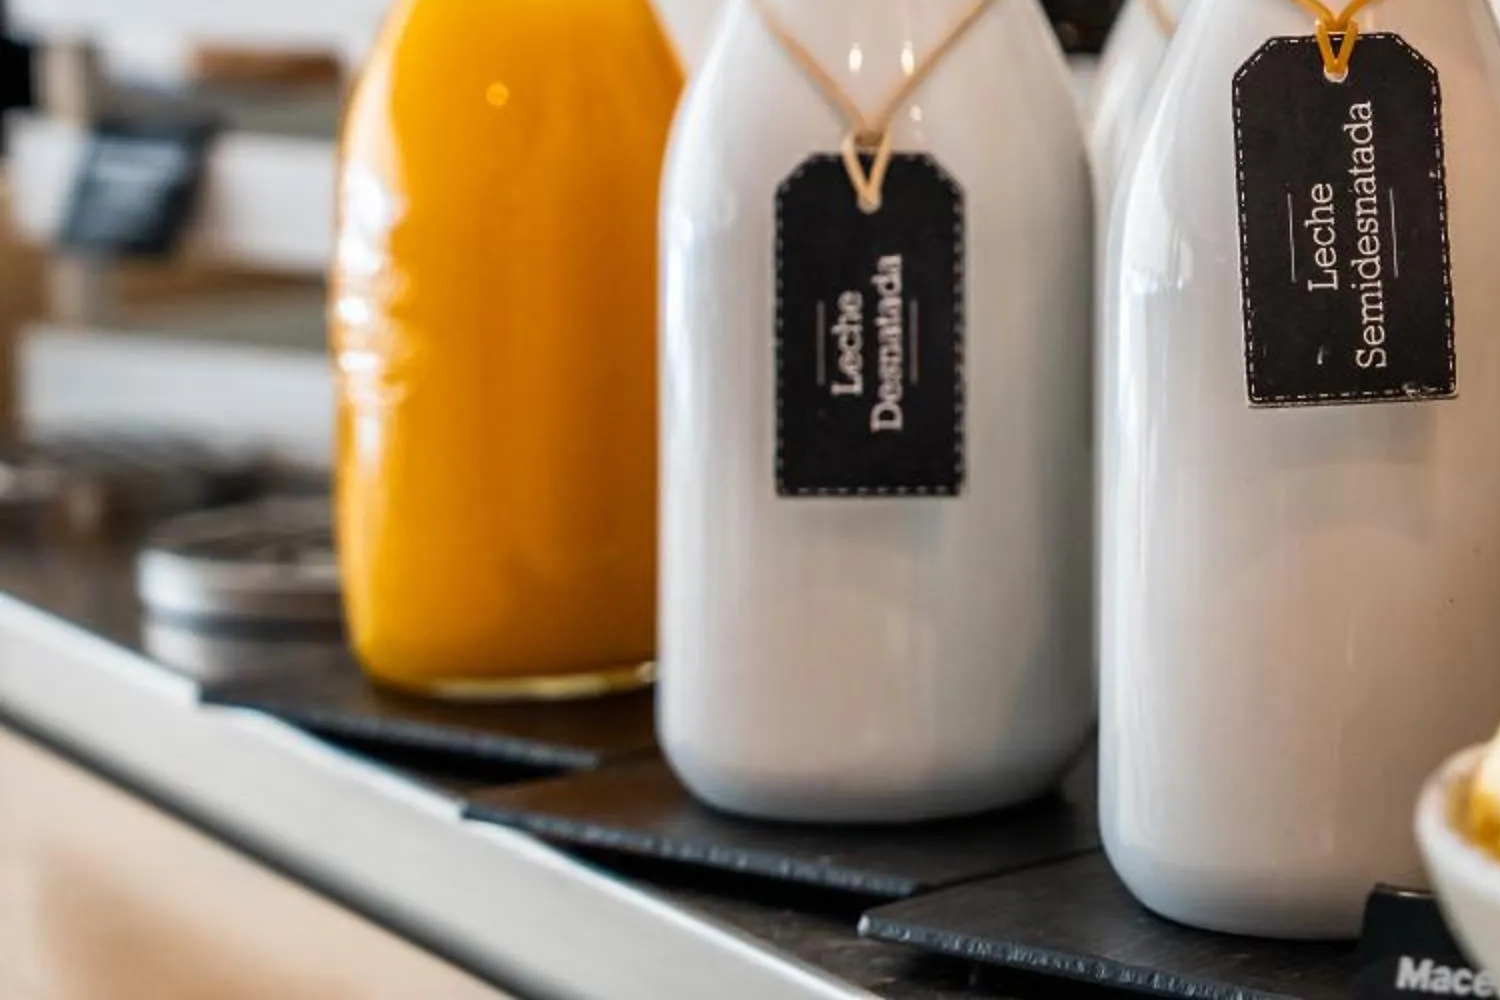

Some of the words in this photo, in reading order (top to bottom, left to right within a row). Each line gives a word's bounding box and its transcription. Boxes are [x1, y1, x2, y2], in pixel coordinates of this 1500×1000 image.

[1303, 183, 1339, 291] Leche
[1342, 100, 1387, 368] Semidesnatada
[830, 290, 863, 394] Leche
[870, 254, 903, 431] Desnatada
